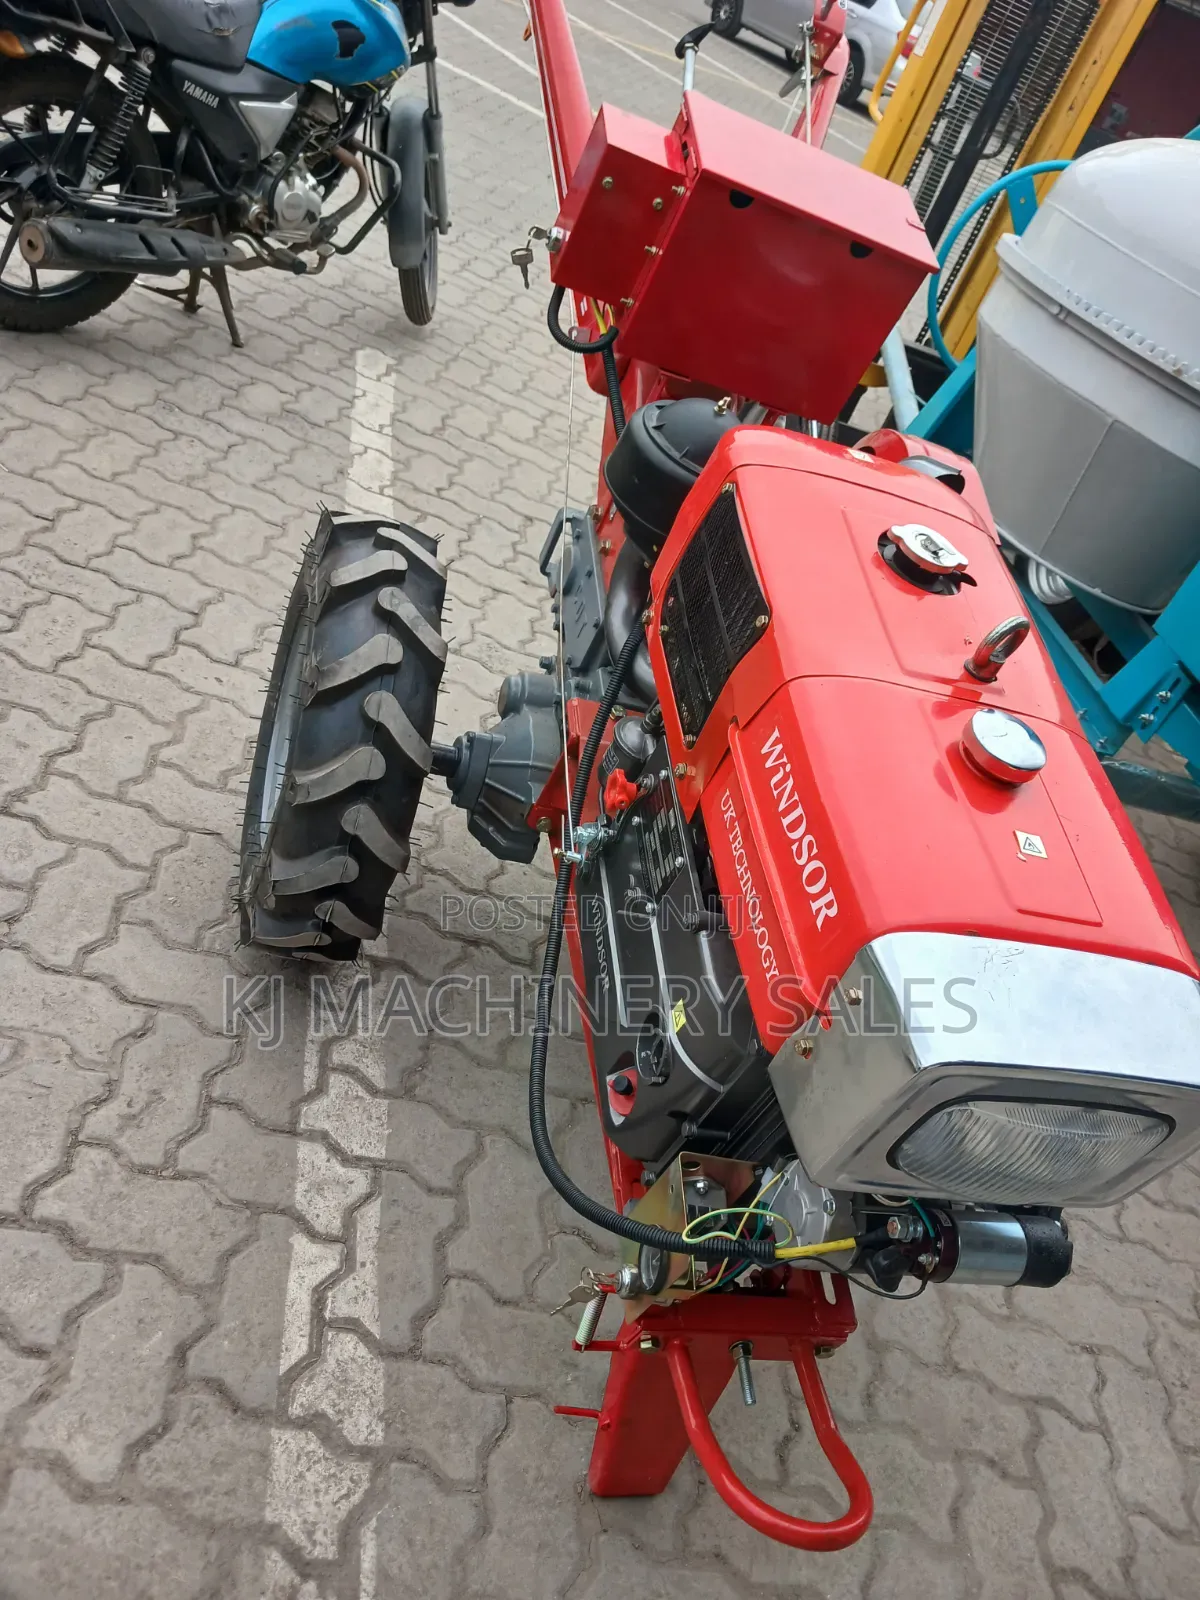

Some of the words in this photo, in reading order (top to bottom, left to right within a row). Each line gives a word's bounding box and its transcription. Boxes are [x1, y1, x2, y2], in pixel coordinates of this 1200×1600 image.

[182, 79, 220, 109] YAMAHA
[720, 788, 737, 829] UK
[729, 820, 780, 983] TECHNOLOGY
